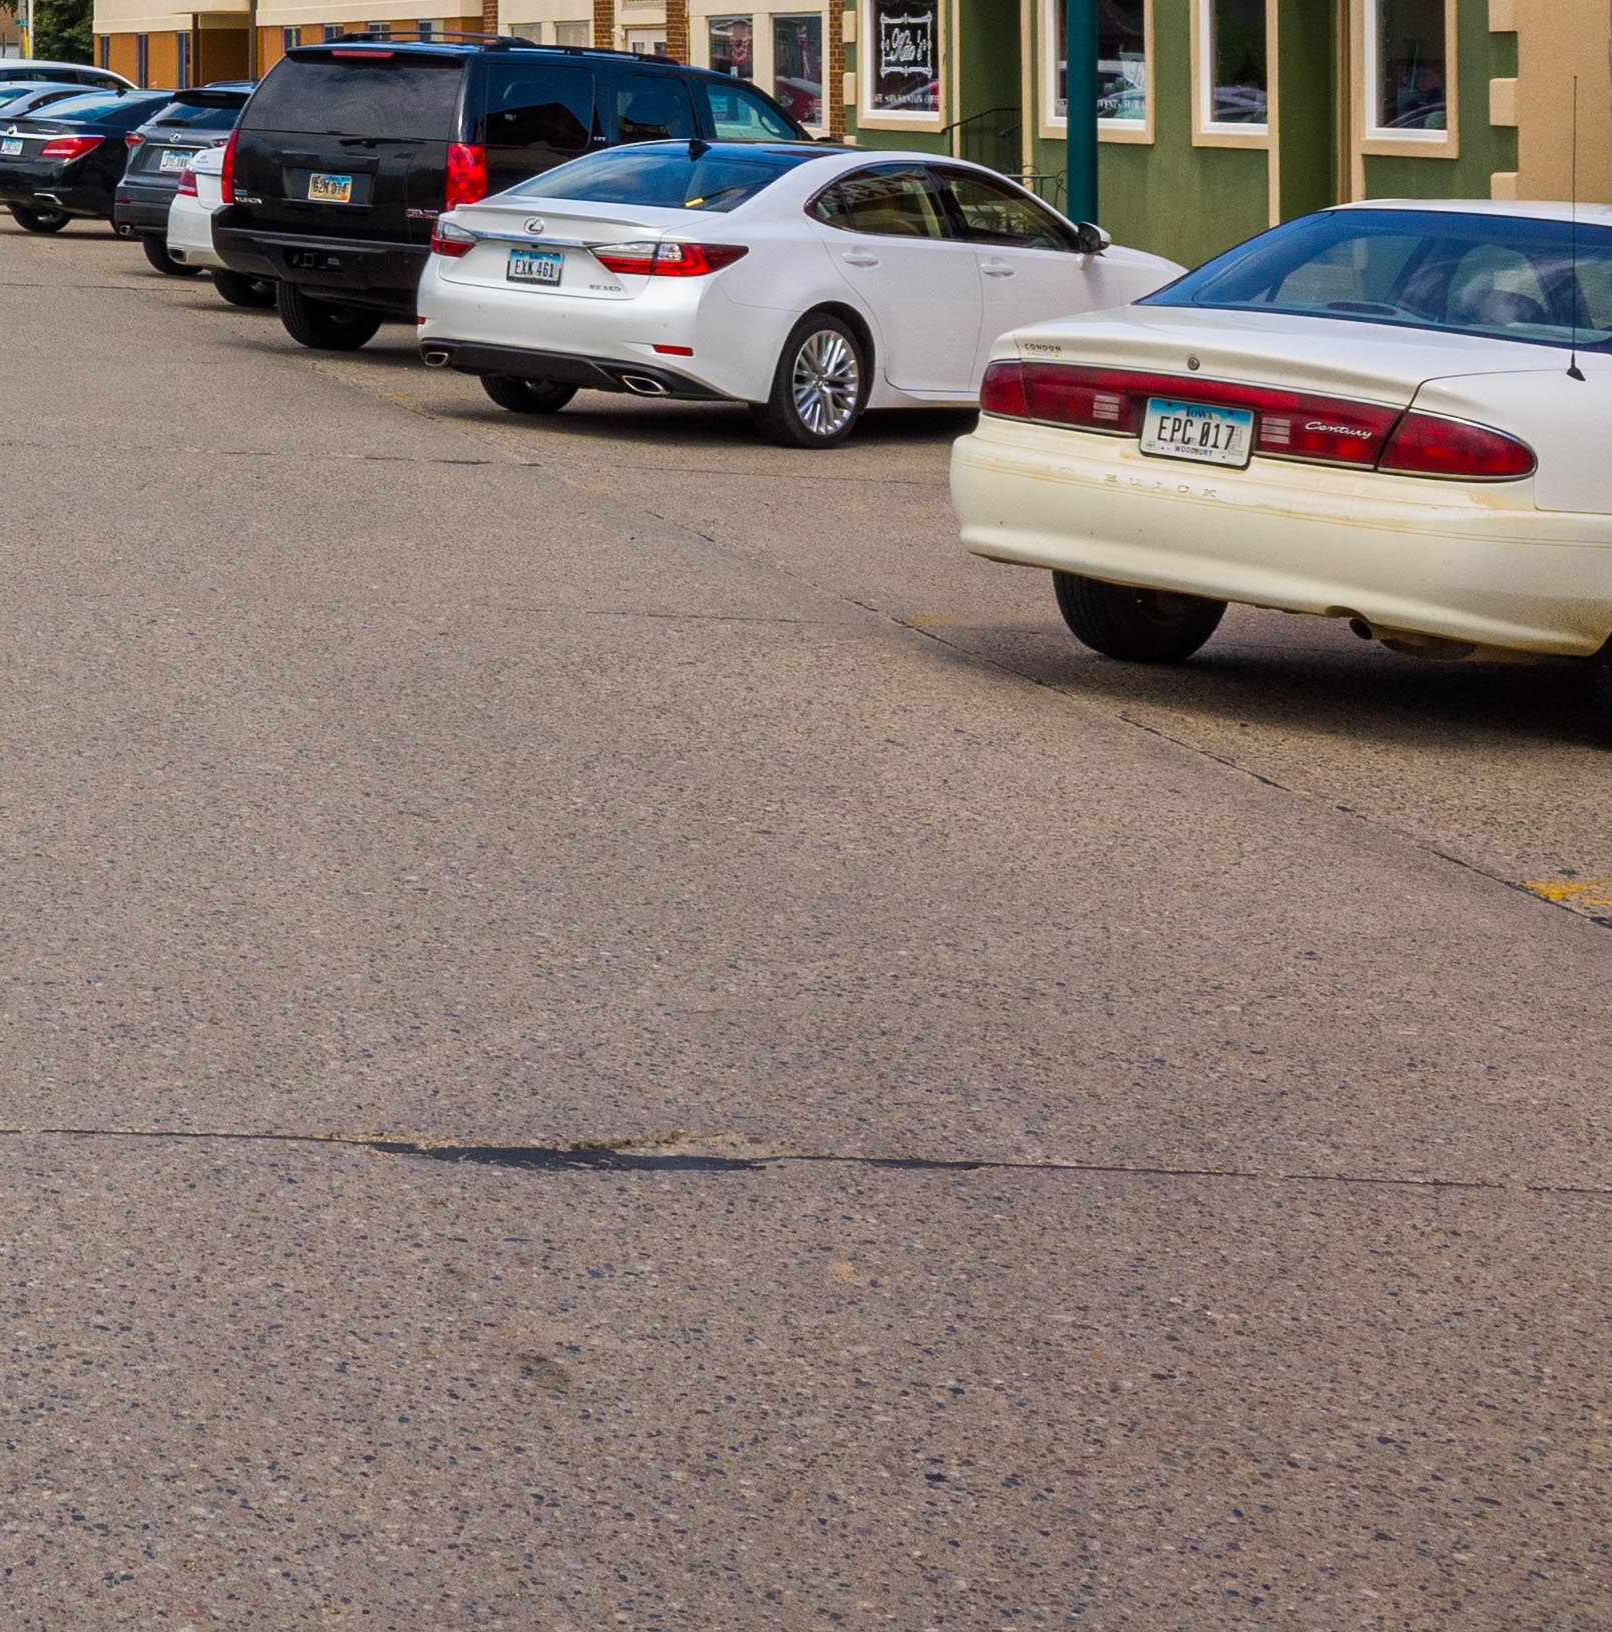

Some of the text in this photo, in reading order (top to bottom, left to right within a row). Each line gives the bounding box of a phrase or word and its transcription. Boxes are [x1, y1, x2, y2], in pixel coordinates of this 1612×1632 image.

[536, 261, 554, 279] 461
[1024, 343, 1062, 352] CONDON
[1157, 415, 1235, 450] EPC 017
[1304, 421, 1373, 439] Century
[1175, 445, 1214, 457] WOODBURY
[1103, 473, 1218, 499] BUICK
